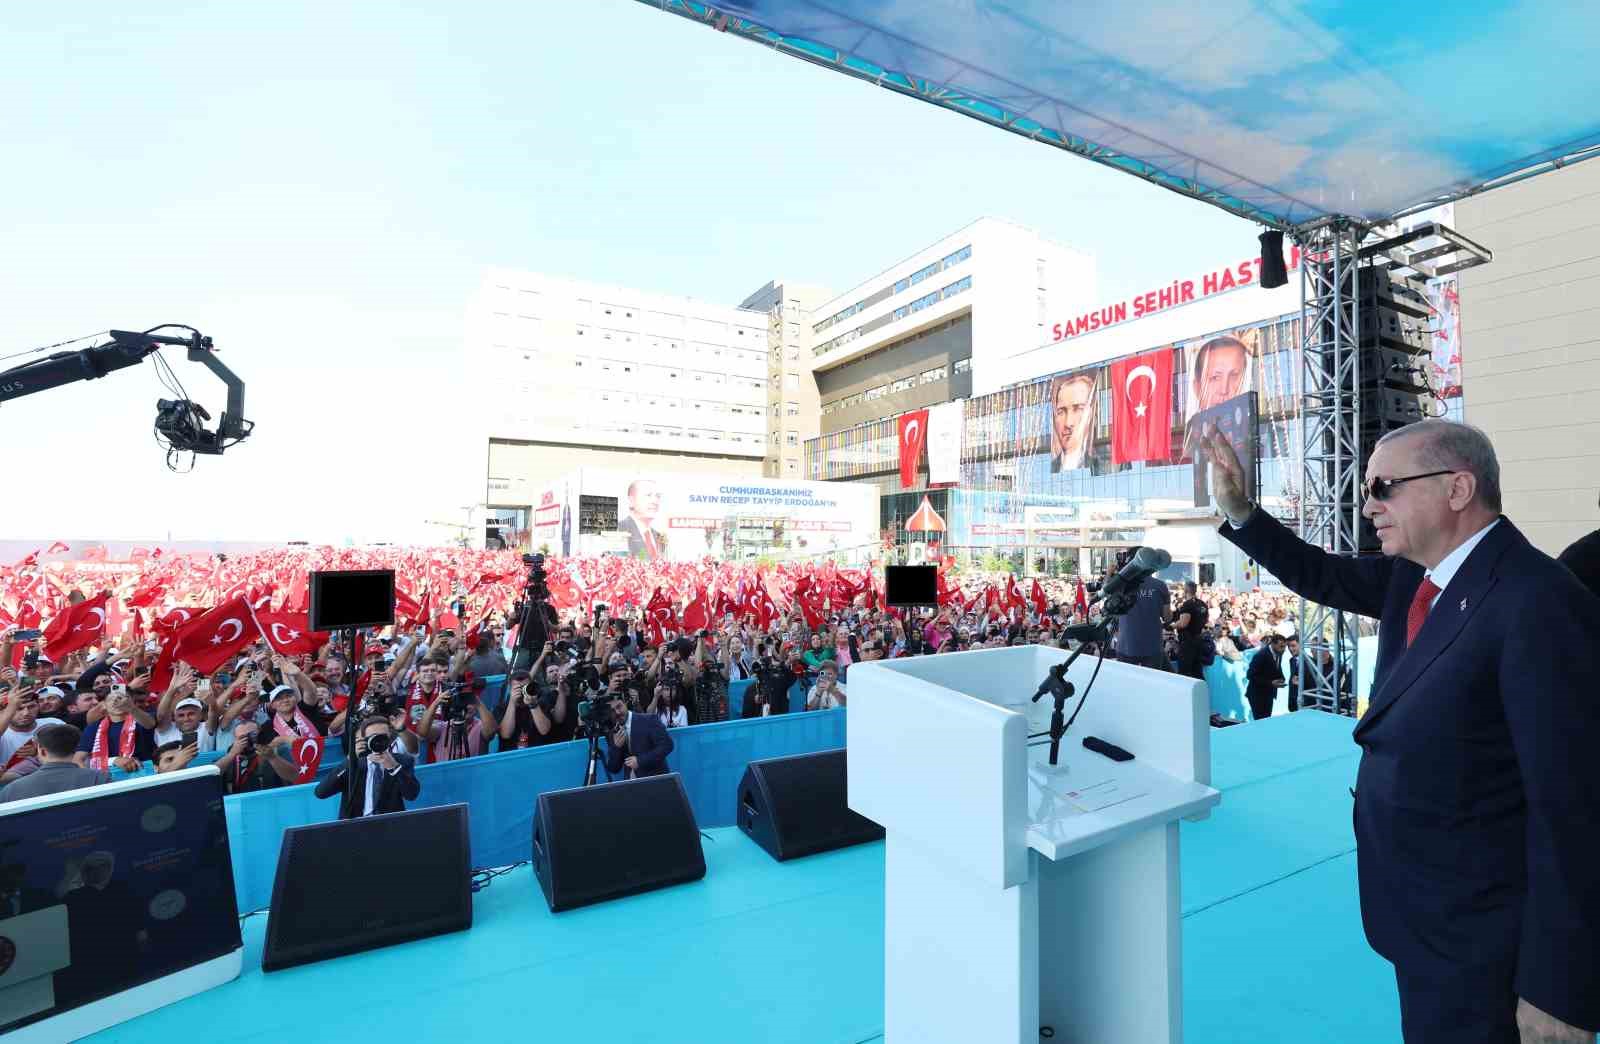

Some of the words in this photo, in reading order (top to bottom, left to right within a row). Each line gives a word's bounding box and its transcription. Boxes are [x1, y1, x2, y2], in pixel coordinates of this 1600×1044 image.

[1053, 302, 1127, 341] SAMSUN
[1132, 280, 1194, 318] ŞEHİR
[689, 494, 719, 503] SAYIN
[720, 496, 750, 504] RECEP
[752, 496, 783, 505] TAYYİP
